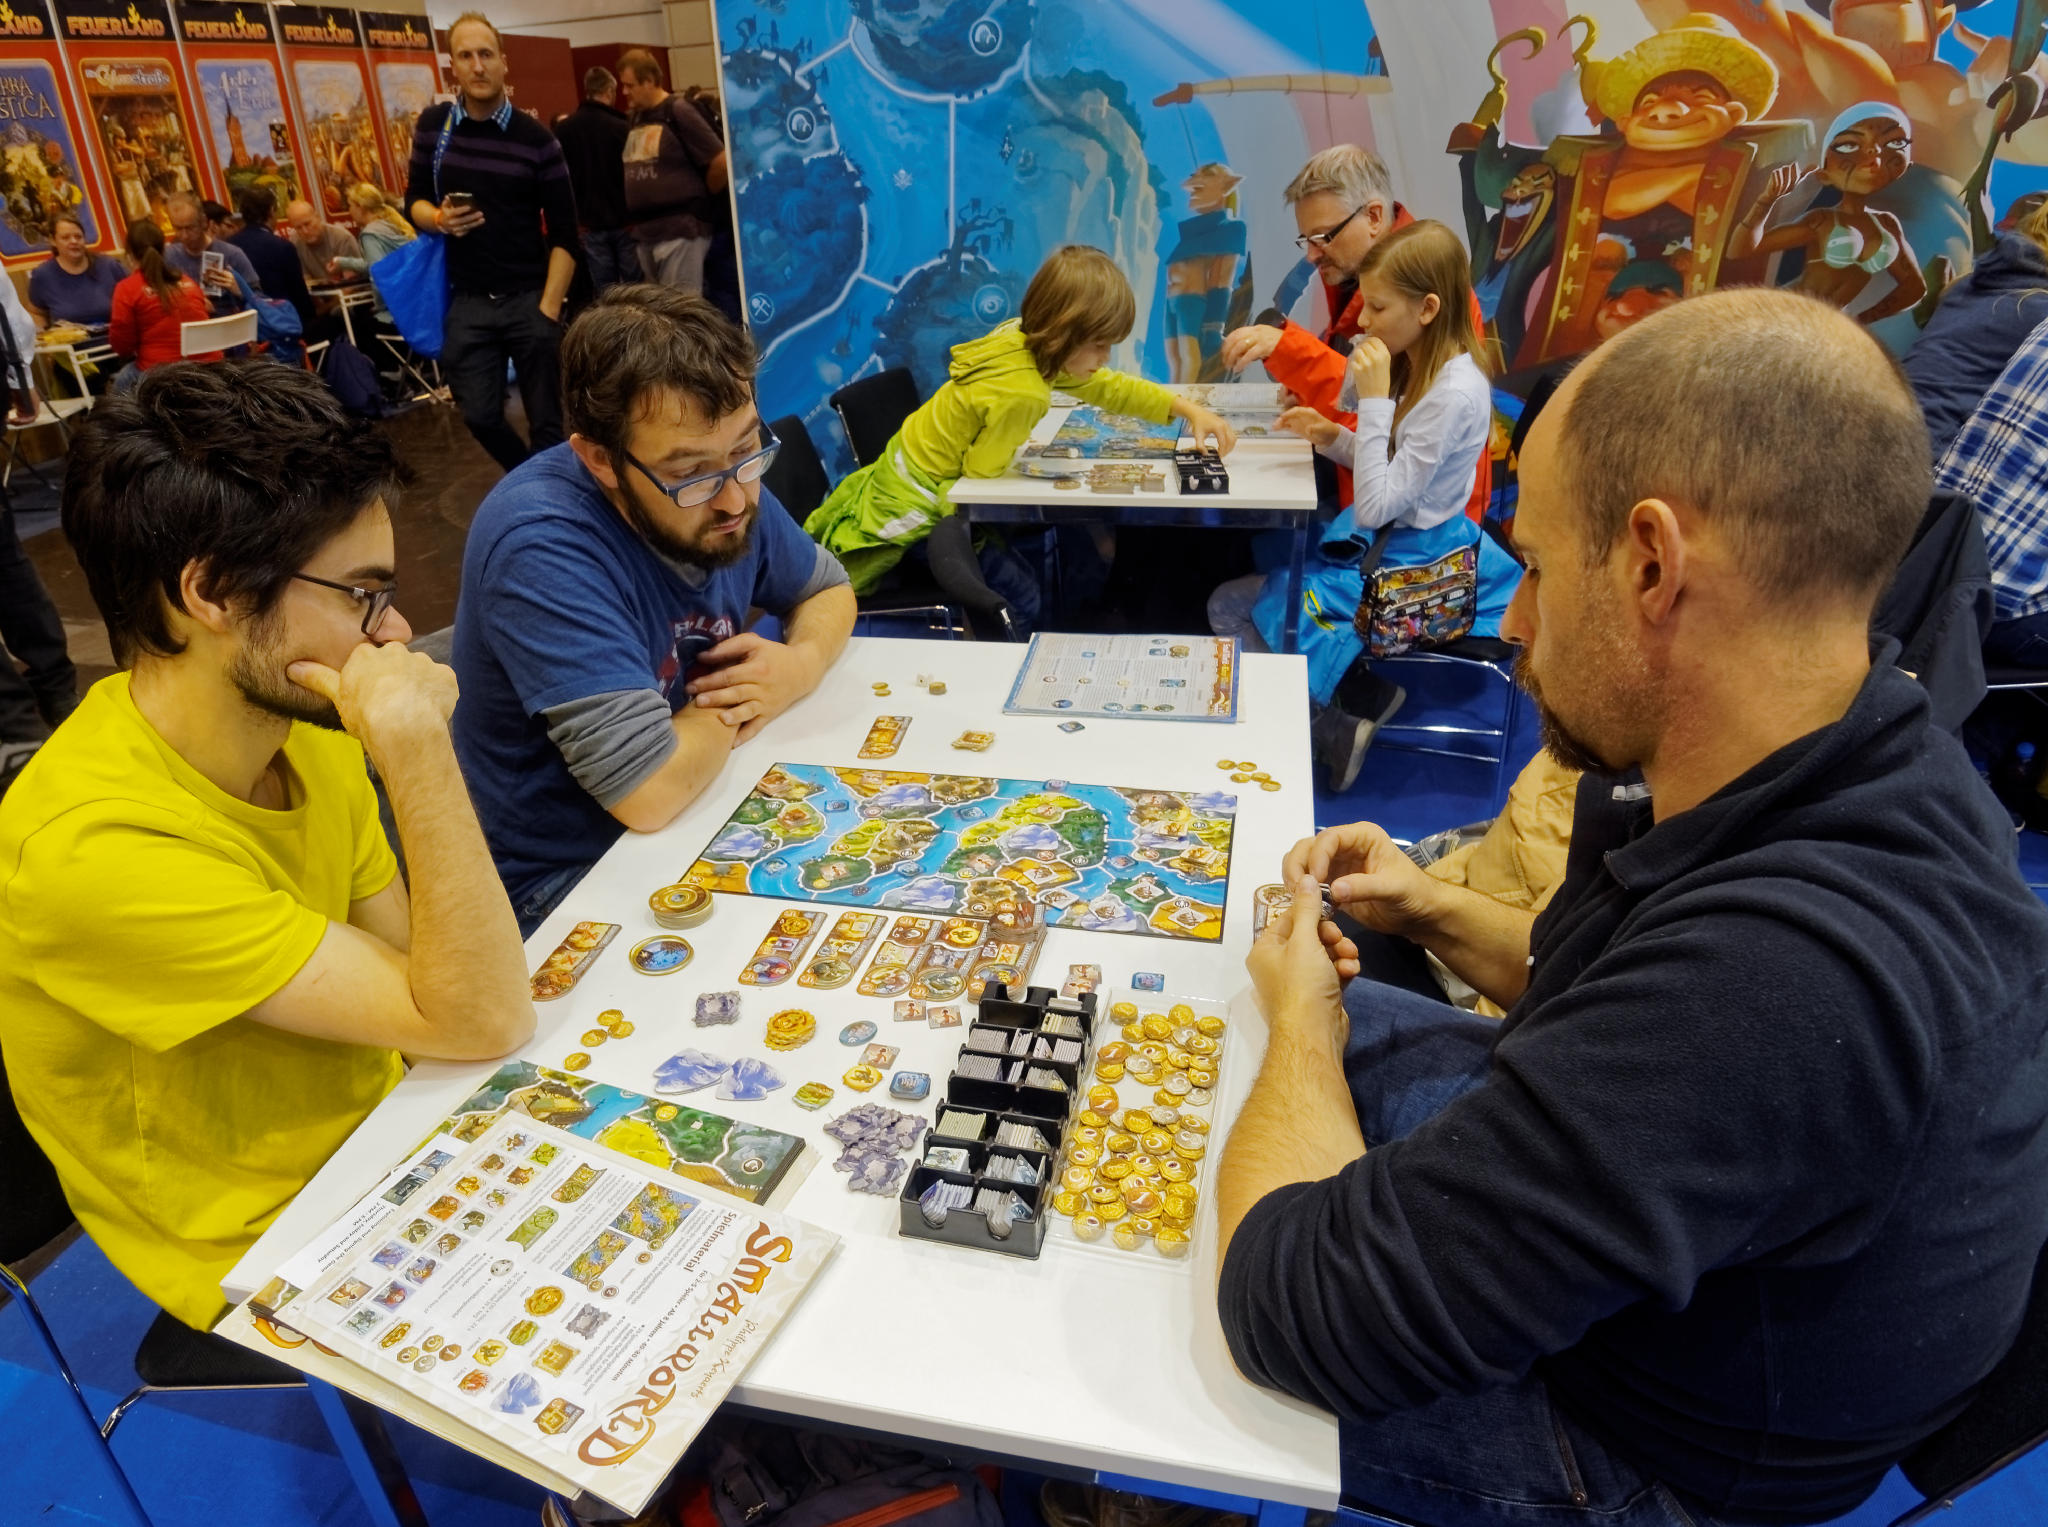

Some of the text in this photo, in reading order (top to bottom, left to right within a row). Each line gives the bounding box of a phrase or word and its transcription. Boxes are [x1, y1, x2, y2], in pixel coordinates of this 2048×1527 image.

[66, 15, 165, 36] FEUERLAND
[184, 20, 267, 39] FEUERLAND
[284, 24, 354, 43] FEUERLAND
[682, 1211, 738, 1273] Spielmaterial
[611, 1357, 633, 1382] Minuten
